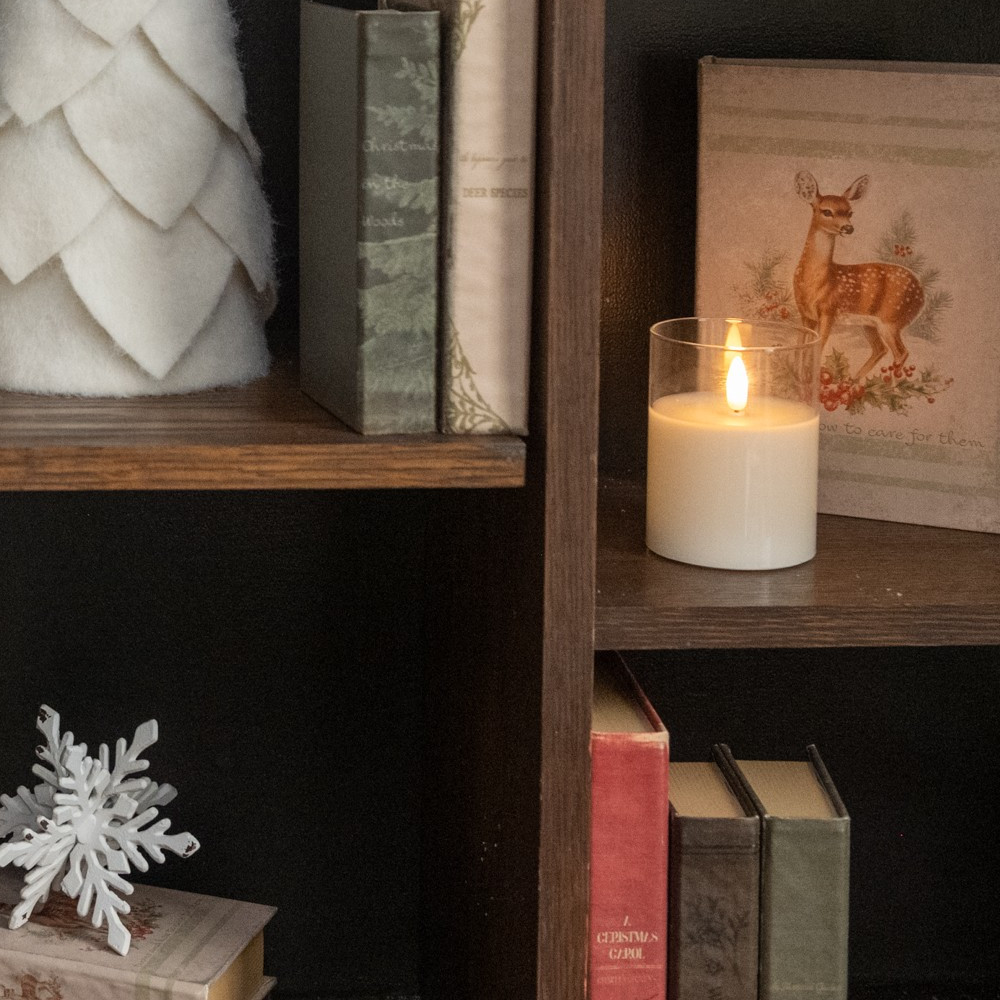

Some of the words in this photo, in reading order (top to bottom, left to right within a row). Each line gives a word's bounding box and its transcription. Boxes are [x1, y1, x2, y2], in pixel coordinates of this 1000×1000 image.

[463, 187, 488, 198] DEER
[490, 187, 529, 198] SPECIES
[843, 422, 862, 436] to
[867, 428, 904, 441] care
[904, 428, 932, 447] for
[938, 431, 985, 448] them
